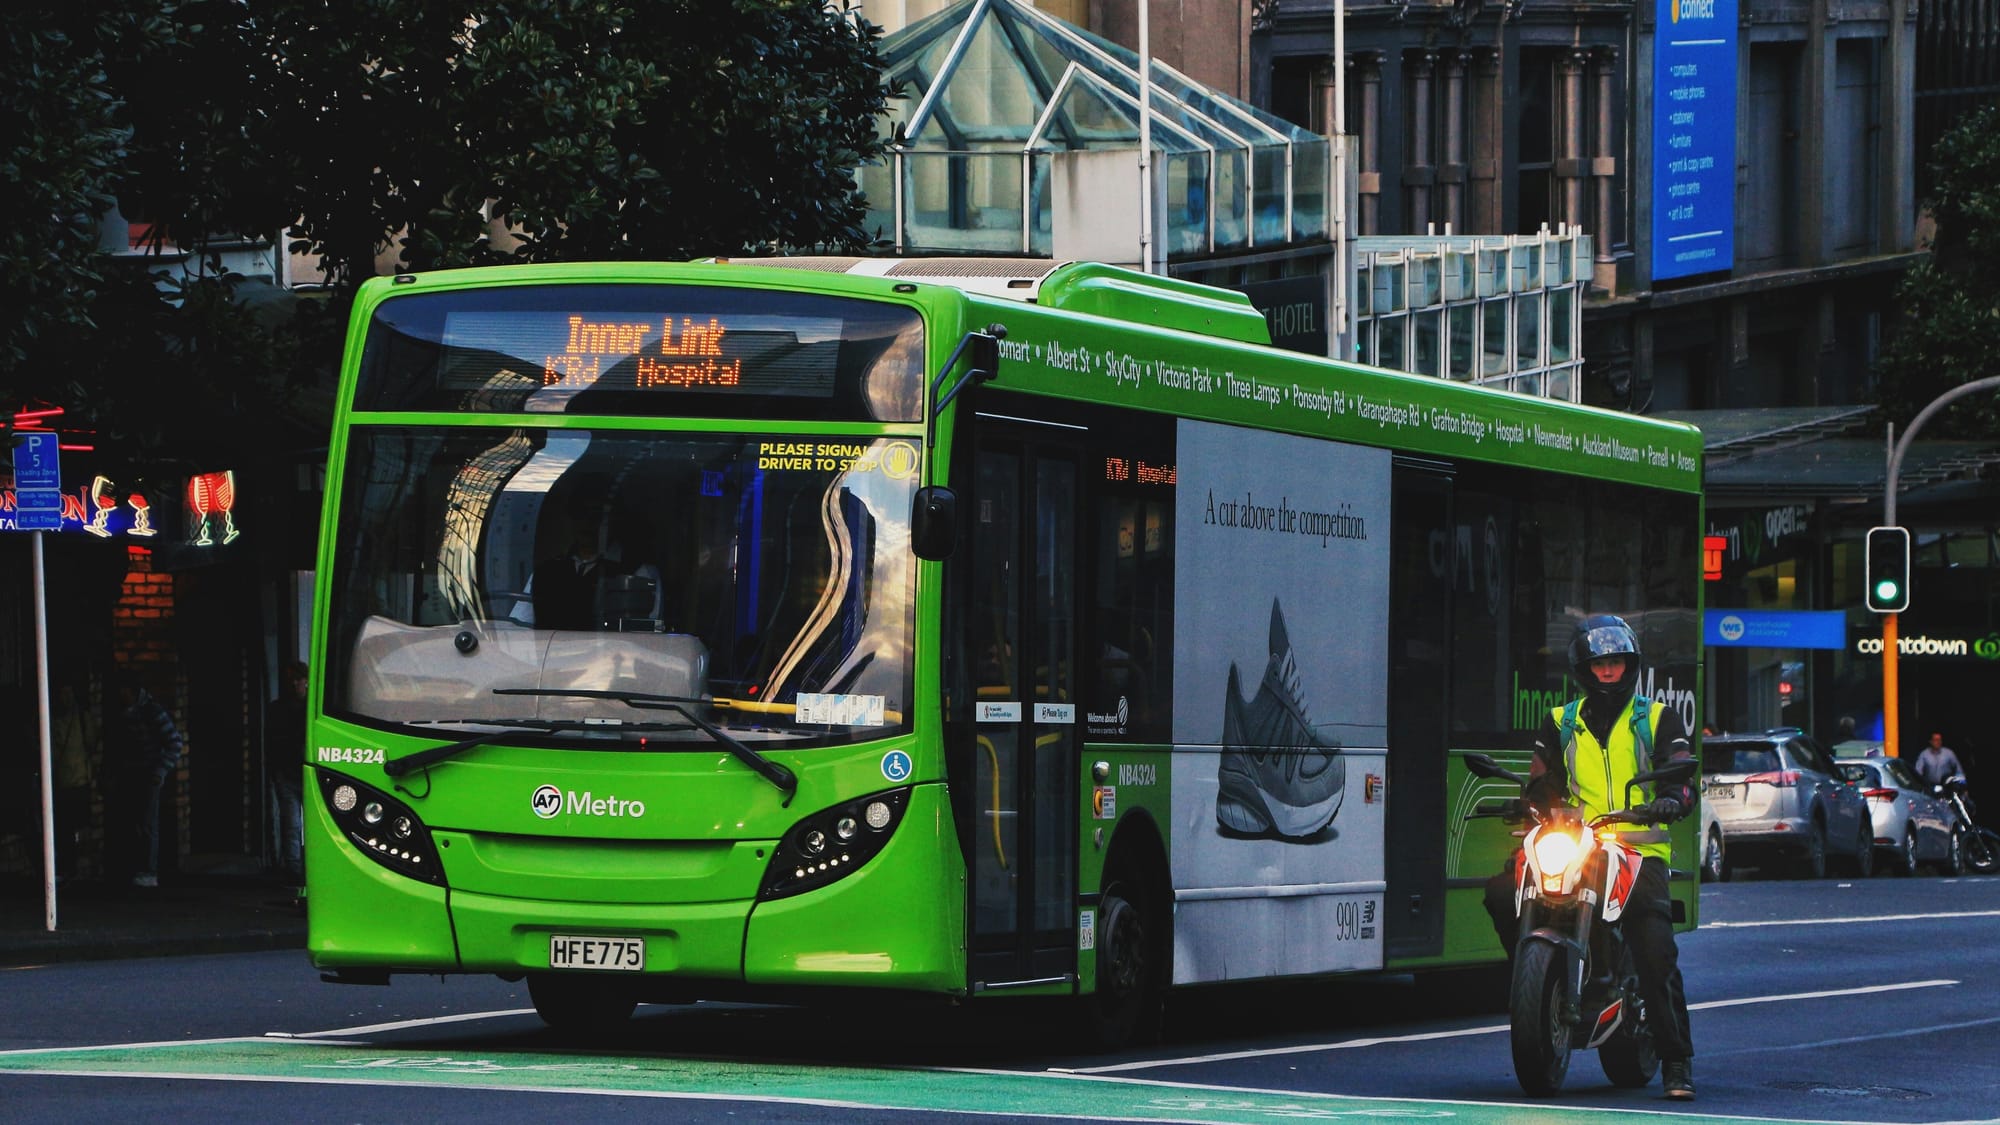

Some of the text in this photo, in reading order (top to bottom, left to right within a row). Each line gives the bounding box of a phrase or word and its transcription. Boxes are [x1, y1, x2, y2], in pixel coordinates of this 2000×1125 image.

[1274, 302, 1316, 336] HOTEL
[566, 316, 726, 356] Inner Link
[636, 357, 741, 388] Hospital
[1046, 341, 1077, 371] Albert
[1080, 346, 1091, 373] St
[1105, 350, 1141, 389] SkyCity
[1155, 359, 1190, 391] Victoria
[1192, 366, 1212, 393] Park
[1225, 371, 1250, 398] Three
[1252, 376, 1281, 410] Lamps
[1292, 383, 1333, 419] Ponsonby
[1334, 390, 1345, 414] Rd
[1357, 394, 1408, 430] Karangahape
[1409, 403, 1420, 427] Rd
[1431, 406, 1460, 433] Grafton
[1461, 412, 1485, 444] Bridge
[1495, 418, 1524, 448] Hospital
[1534, 423, 1573, 452] Newmarket
[1582, 434, 1612, 458] Auckland
[1613, 439, 1640, 464] Museum
[1648, 444, 1669, 468] Parnell
[1677, 449, 1696, 473] Arena
[28, 436, 42, 453] P
[760, 443, 871, 458] PLEASE SIGNAL
[33, 454, 40, 467] 5
[758, 458, 878, 473] DRIVER TO STOP
[1204, 488, 1367, 549] A cut above the competition.
[1766, 505, 1796, 548] open
[1722, 623, 1740, 633] WS
[1857, 635, 1967, 655] contdown
[317, 747, 384, 764] NB4324
[1119, 764, 1156, 785] NB4324
[566, 791, 645, 818] Metro
[1336, 902, 1359, 941] 990
[553, 940, 640, 966] HFE775
